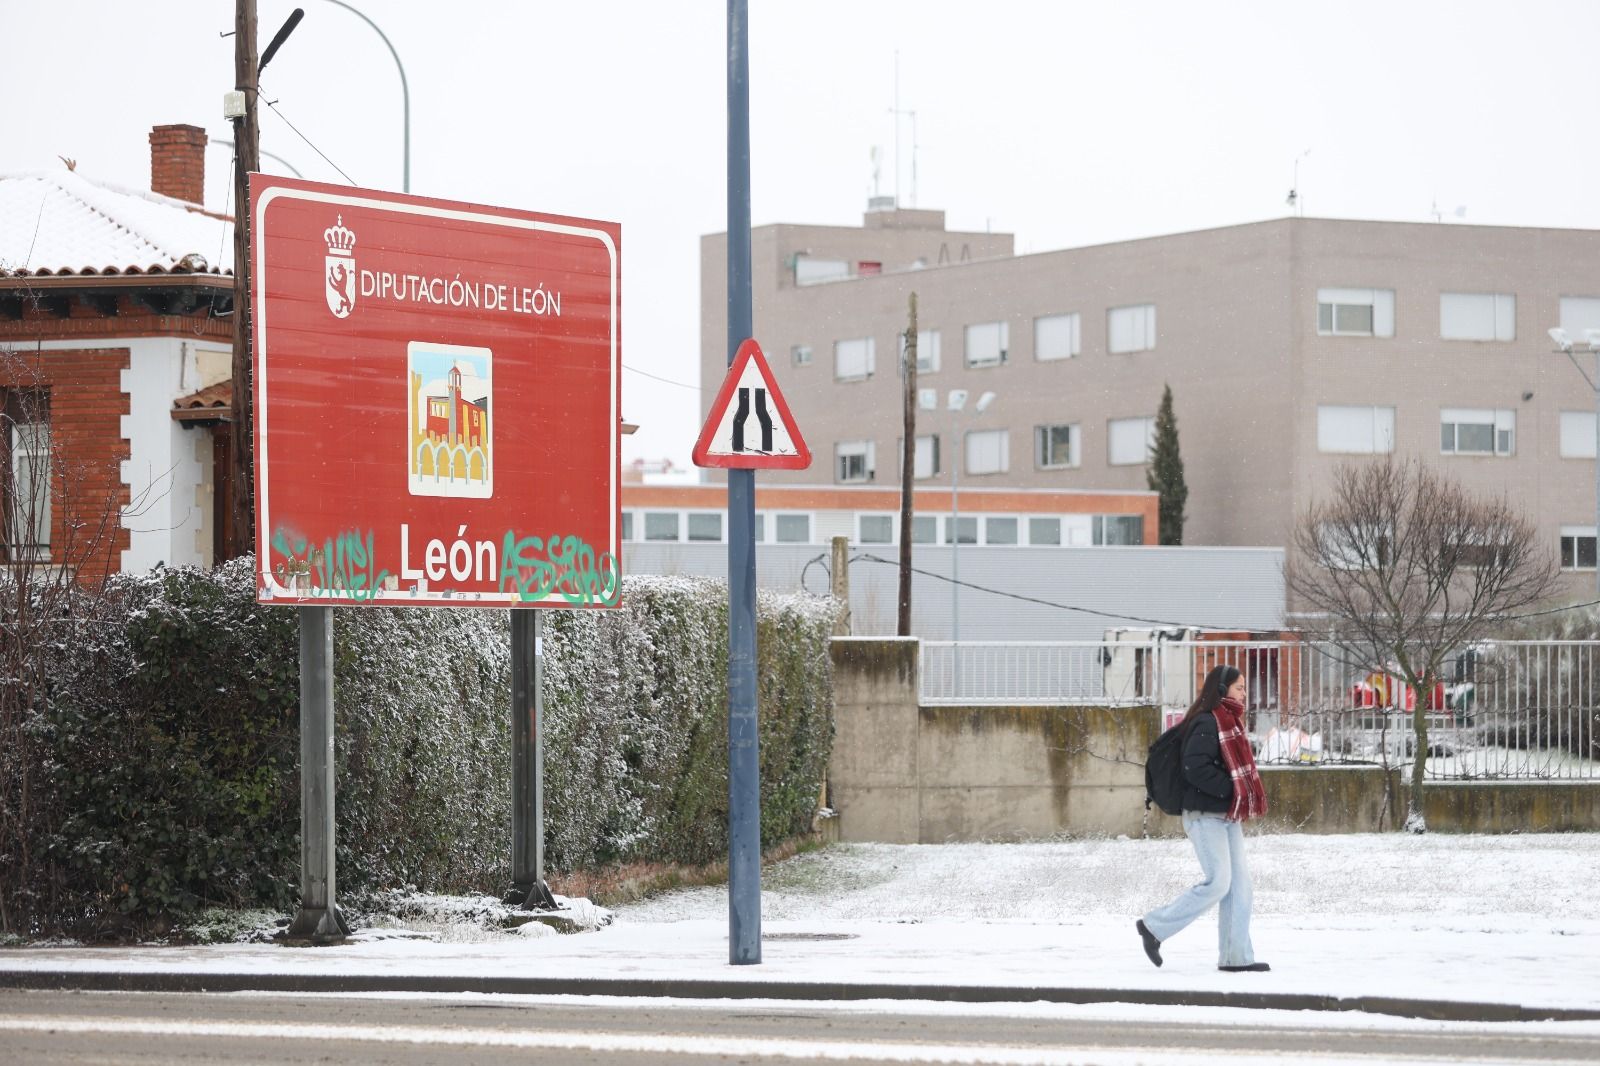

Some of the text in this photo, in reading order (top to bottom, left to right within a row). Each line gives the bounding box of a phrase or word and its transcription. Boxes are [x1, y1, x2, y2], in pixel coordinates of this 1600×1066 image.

[361, 269, 561, 317] DIPUTACIÓN DE LEÓN
[401, 523, 496, 582] León
